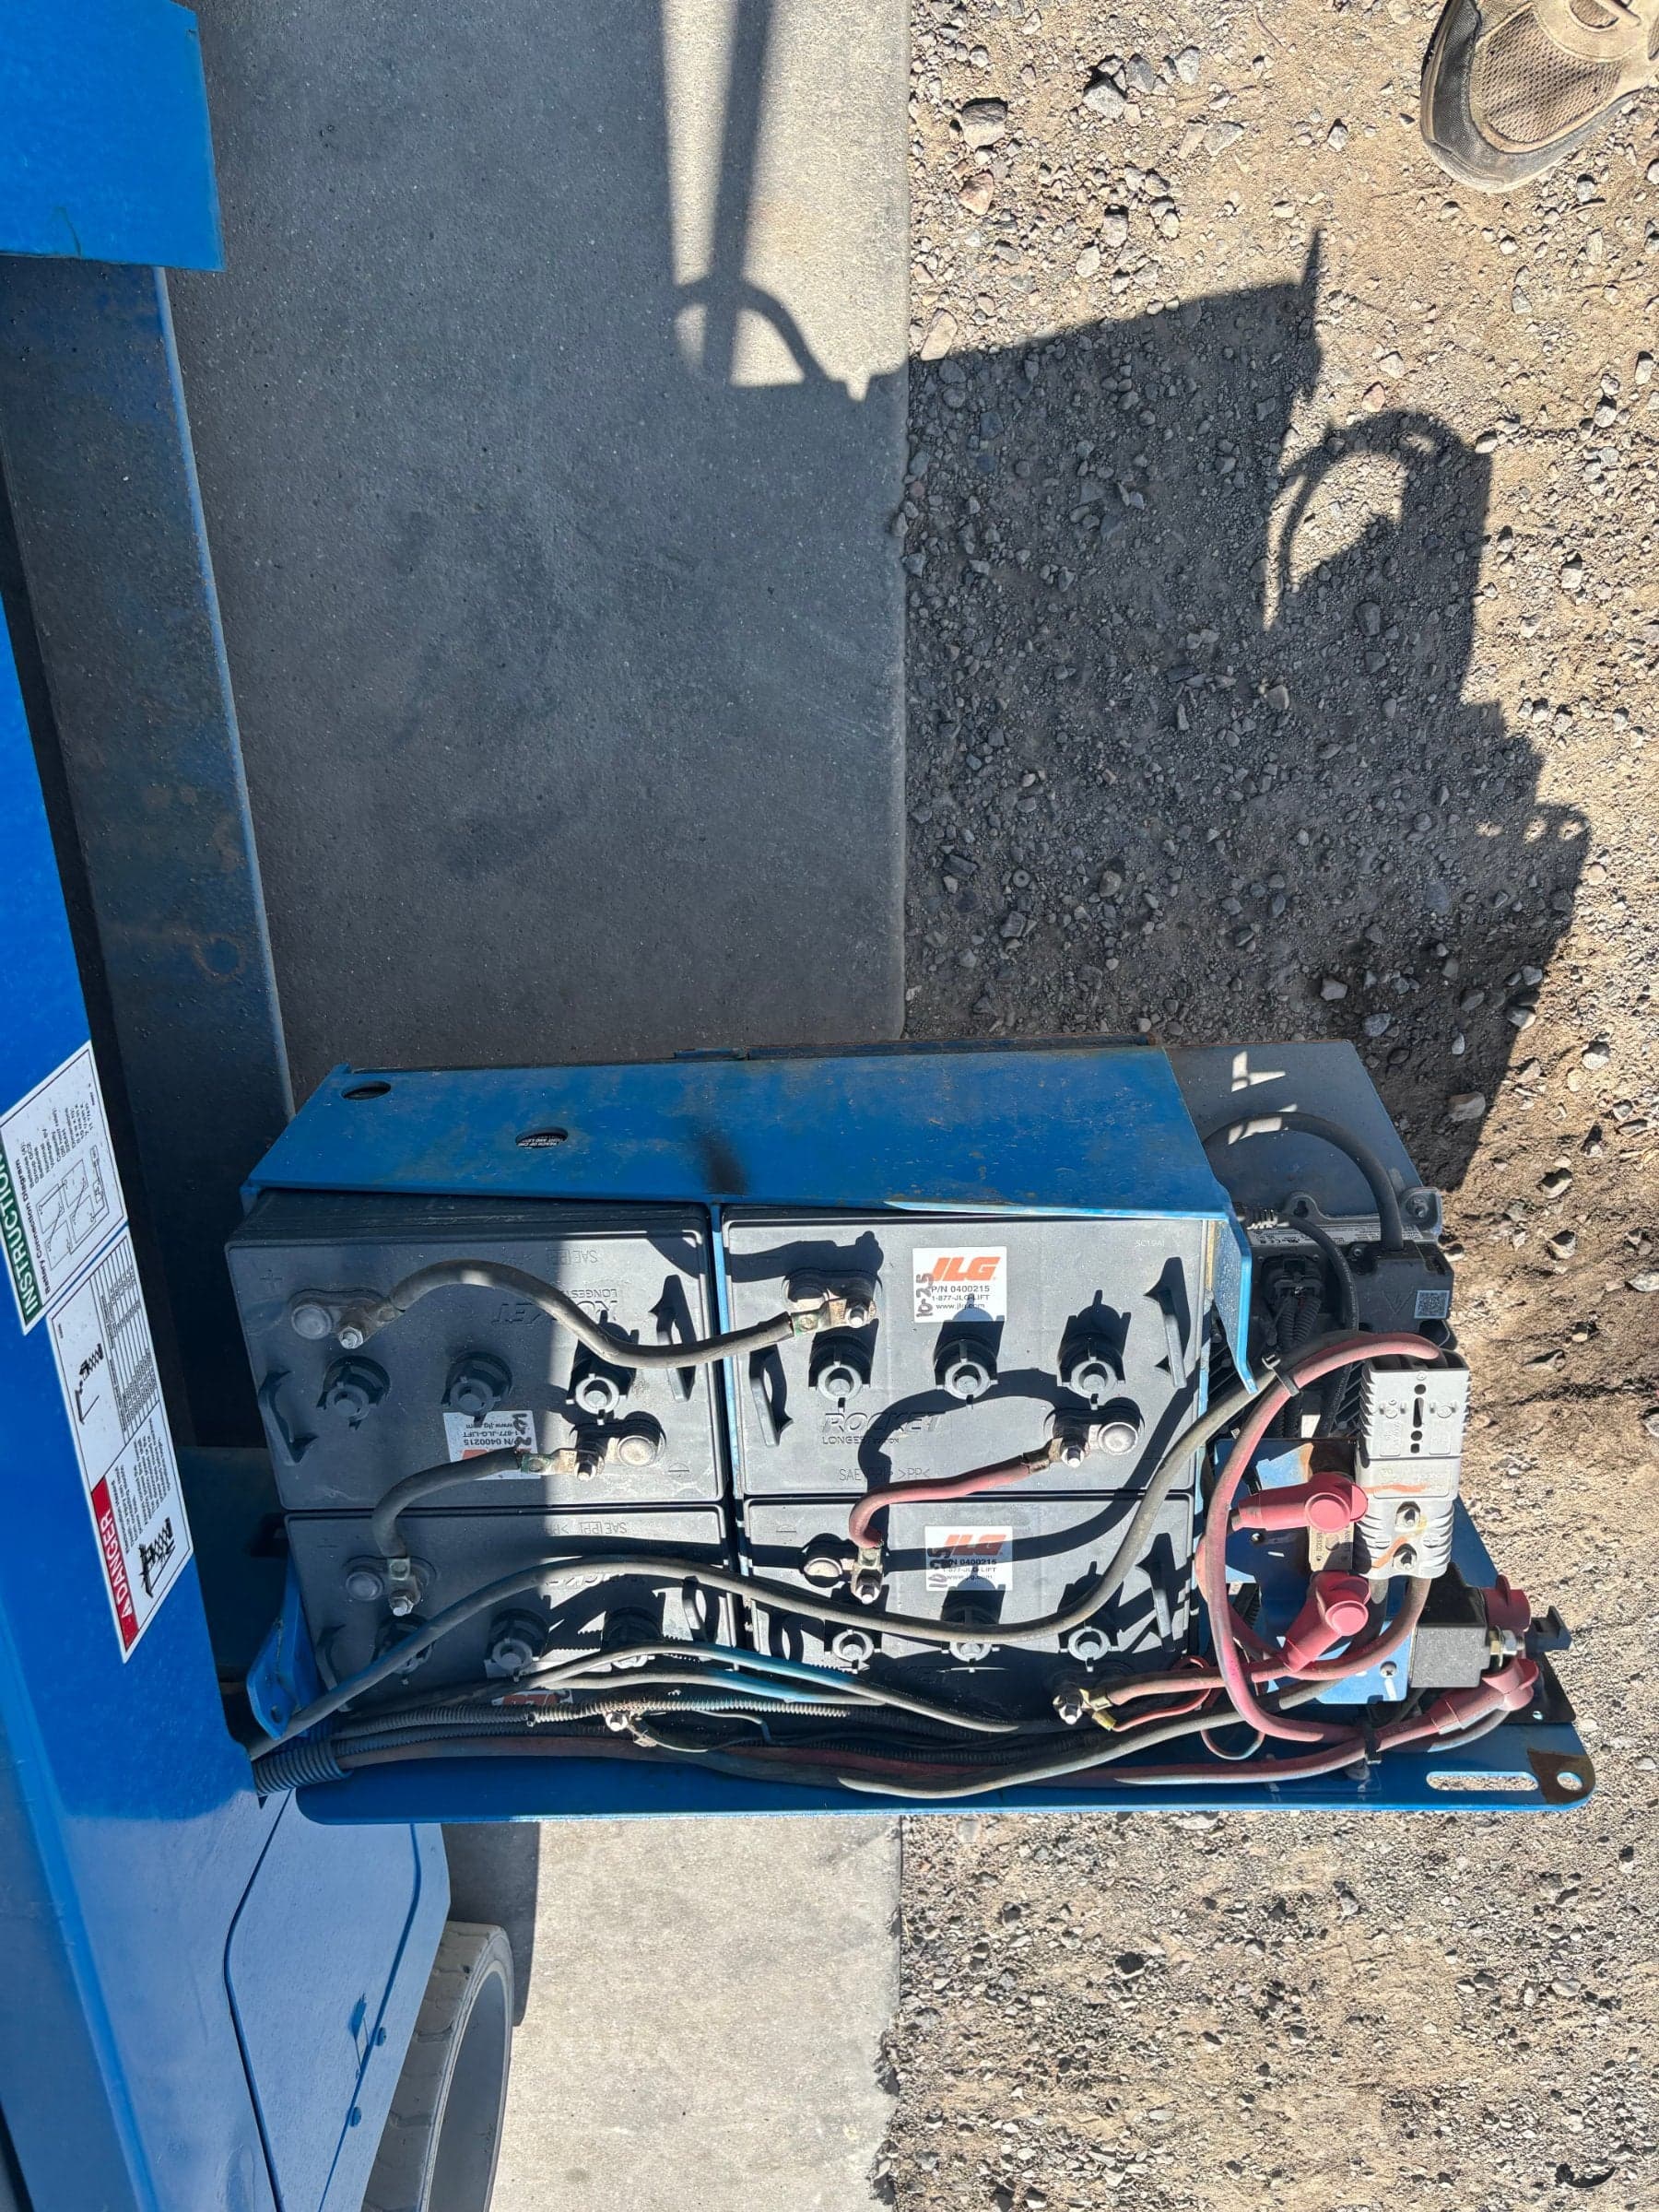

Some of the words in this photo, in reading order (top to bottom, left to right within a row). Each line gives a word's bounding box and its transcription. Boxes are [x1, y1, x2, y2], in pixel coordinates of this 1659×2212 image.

[16, 1159, 29, 1201] Diagram
[26, 1202, 42, 1259] Connection
[933, 1257, 1000, 1281] JLG
[100, 1510, 128, 1606] DANGER
[945, 1535, 1006, 1556] JLG
